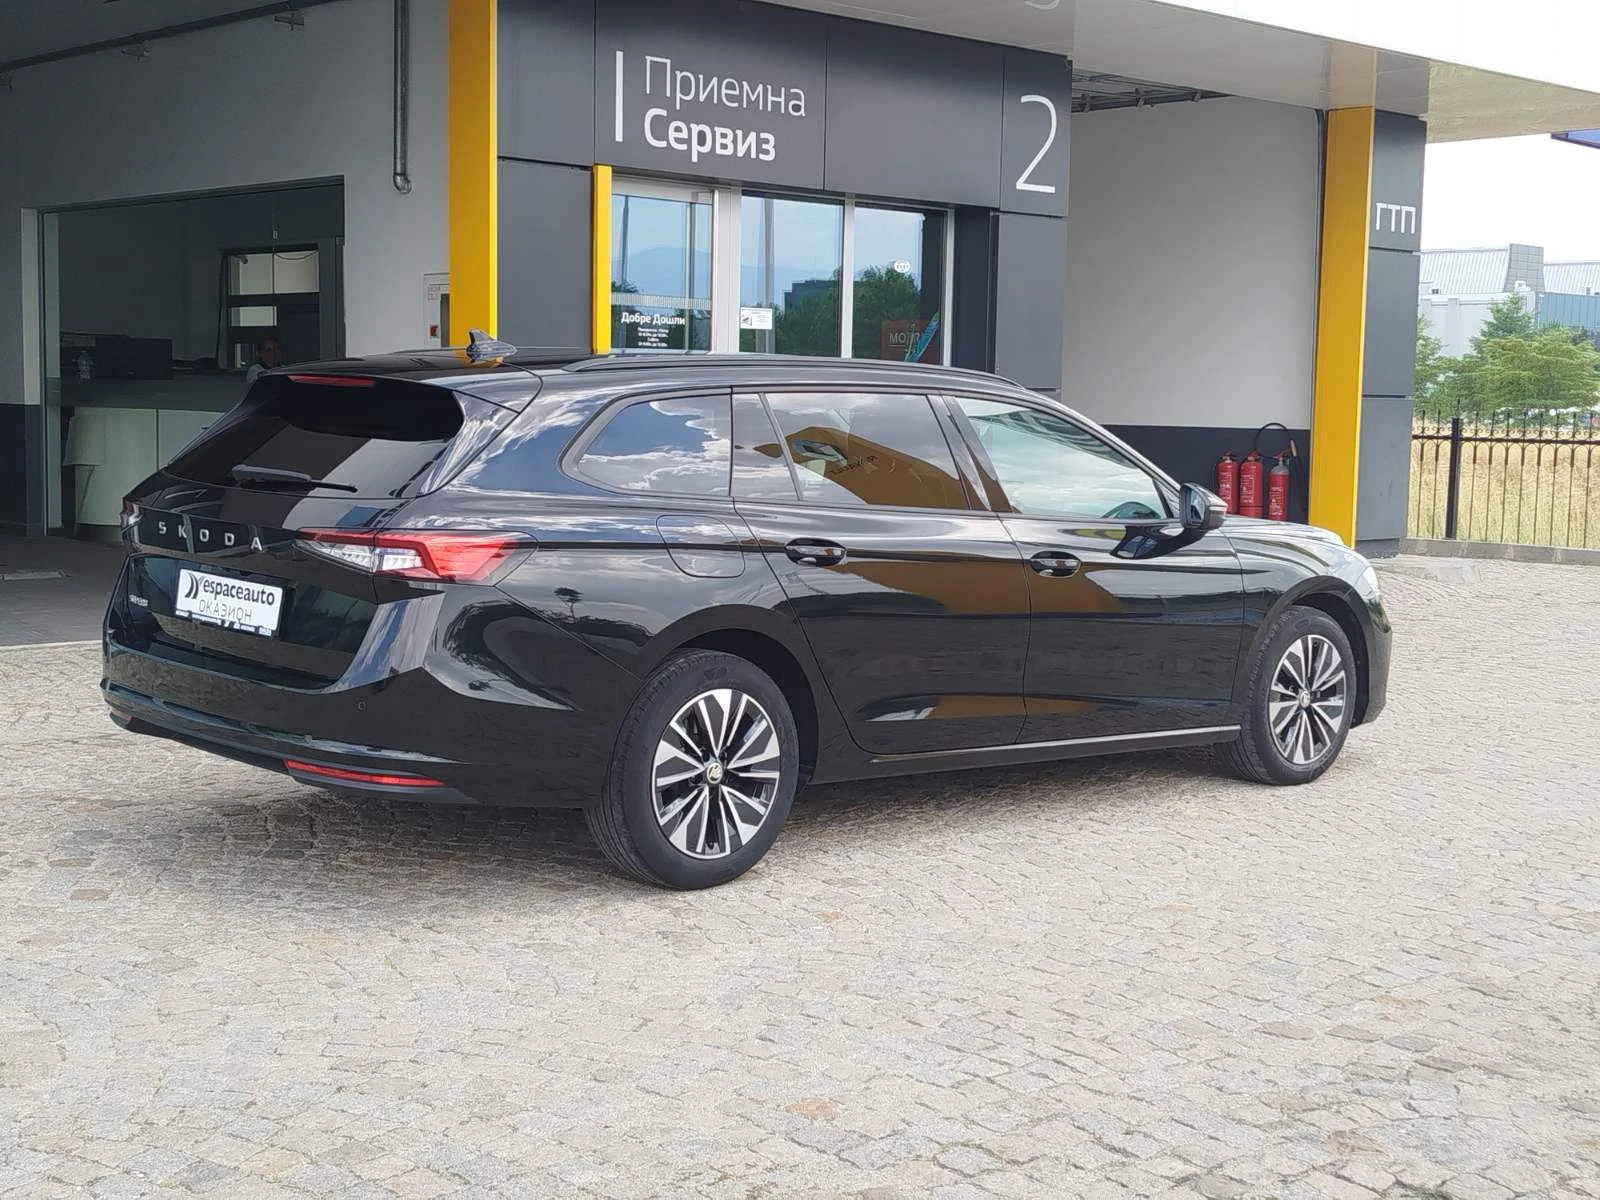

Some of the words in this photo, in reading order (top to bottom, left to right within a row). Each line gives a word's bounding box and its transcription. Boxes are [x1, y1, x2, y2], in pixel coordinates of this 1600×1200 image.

[645, 55, 806, 117] Приемна
[643, 108, 776, 162] Сервиз
[1014, 94, 1057, 194] 2
[1375, 202, 1417, 235] ГТП
[620, 311, 651, 326] Добре
[652, 313, 686, 327] Дошли
[158, 521, 263, 551] SKODA
[202, 580, 276, 606] espaceauto
[198, 598, 253, 623] ОКАЗИОН
